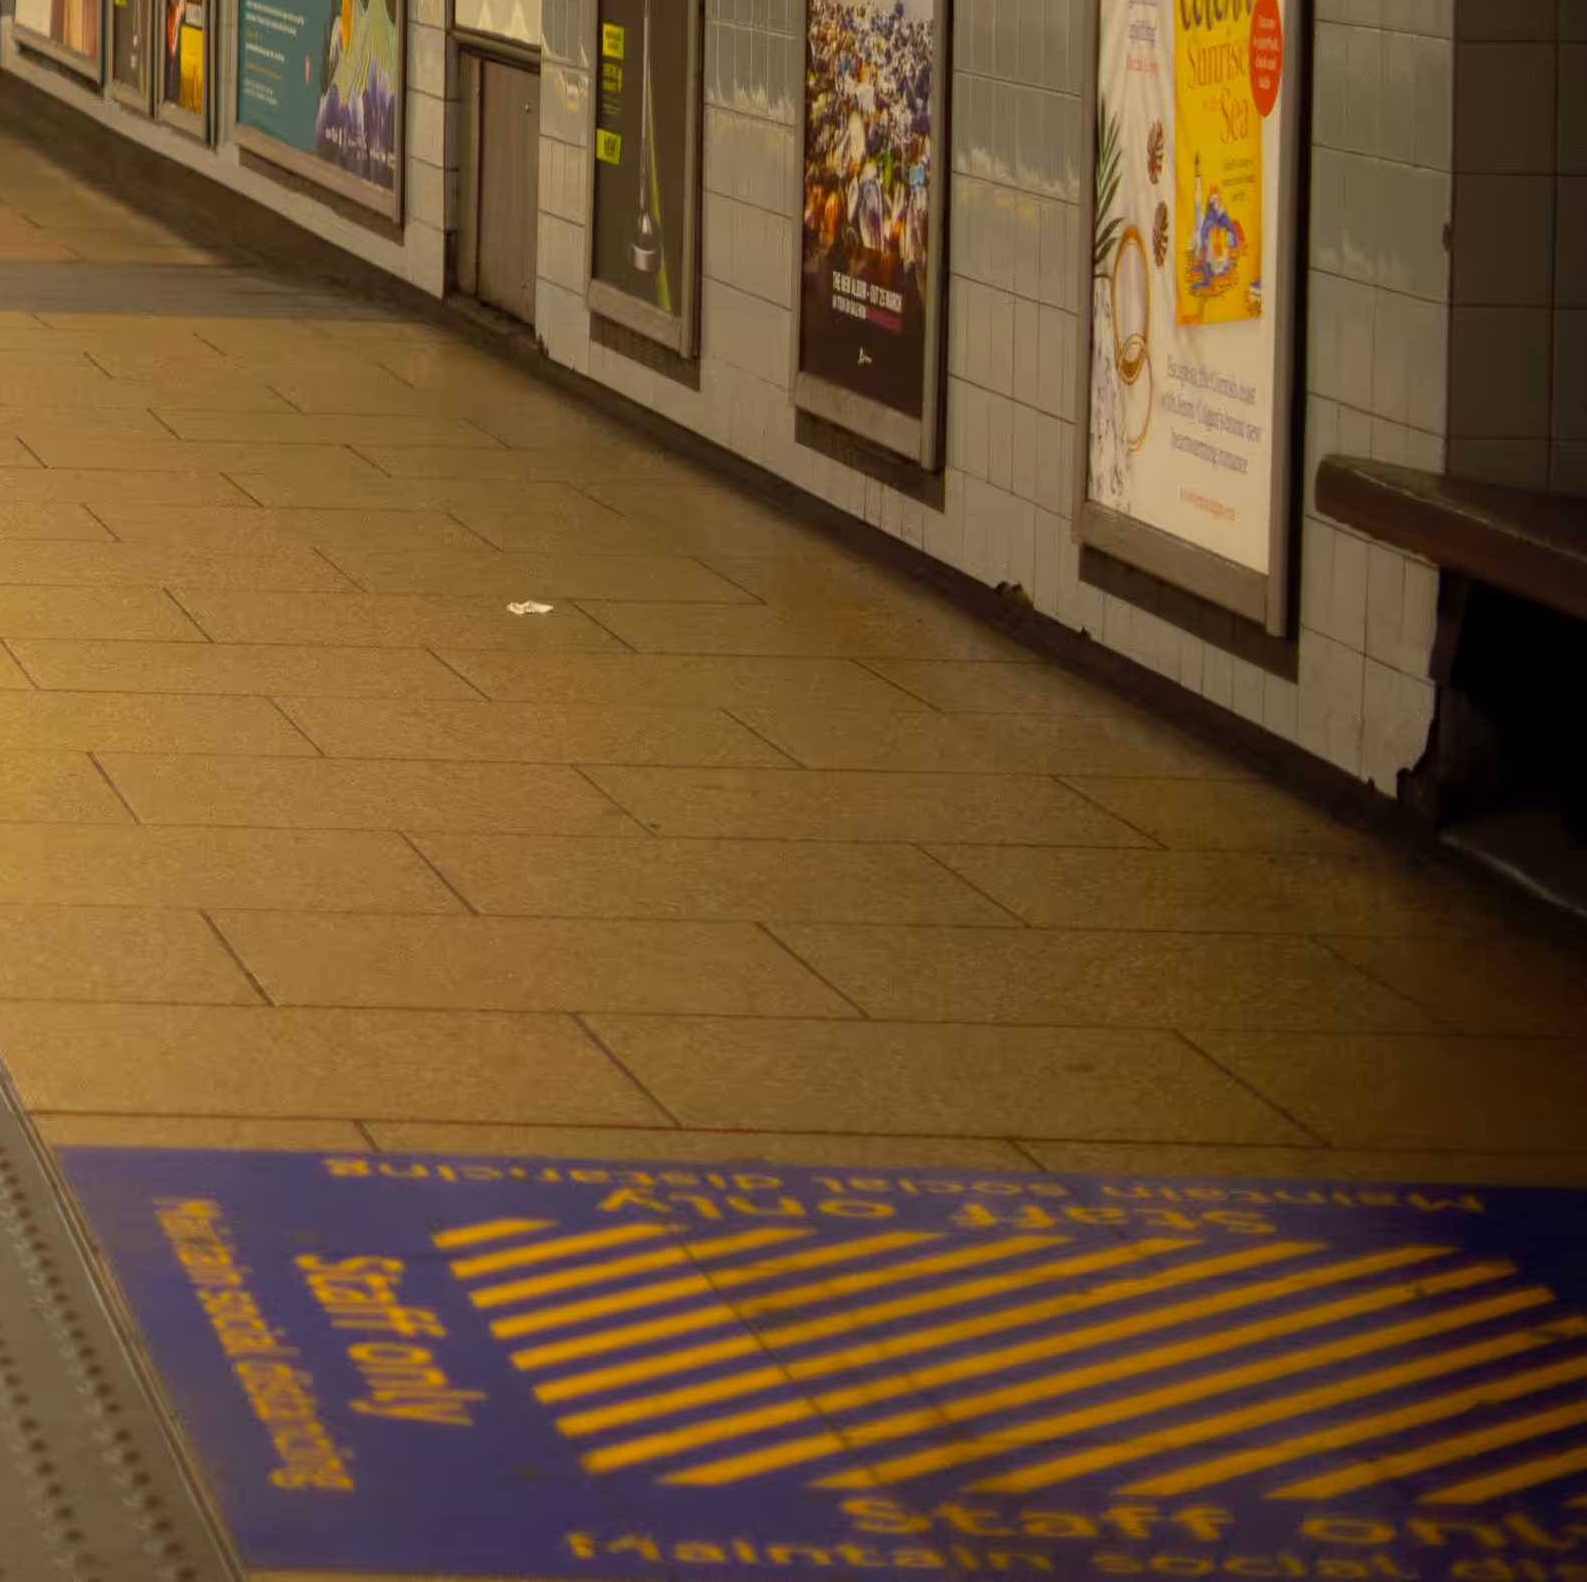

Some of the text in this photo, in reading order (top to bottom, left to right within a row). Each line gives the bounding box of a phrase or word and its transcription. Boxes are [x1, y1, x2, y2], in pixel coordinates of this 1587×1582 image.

[1187, 29, 1247, 90] Sunrise
[1220, 87, 1250, 145] Sea
[322, 1159, 1485, 1214] Maintain social distancing
[595, 1186, 1276, 1235] Staff only
[293, 1254, 488, 1426] Staff only
[839, 1495, 1235, 1541] Staff
[564, 1531, 1400, 1577] Maintain social
